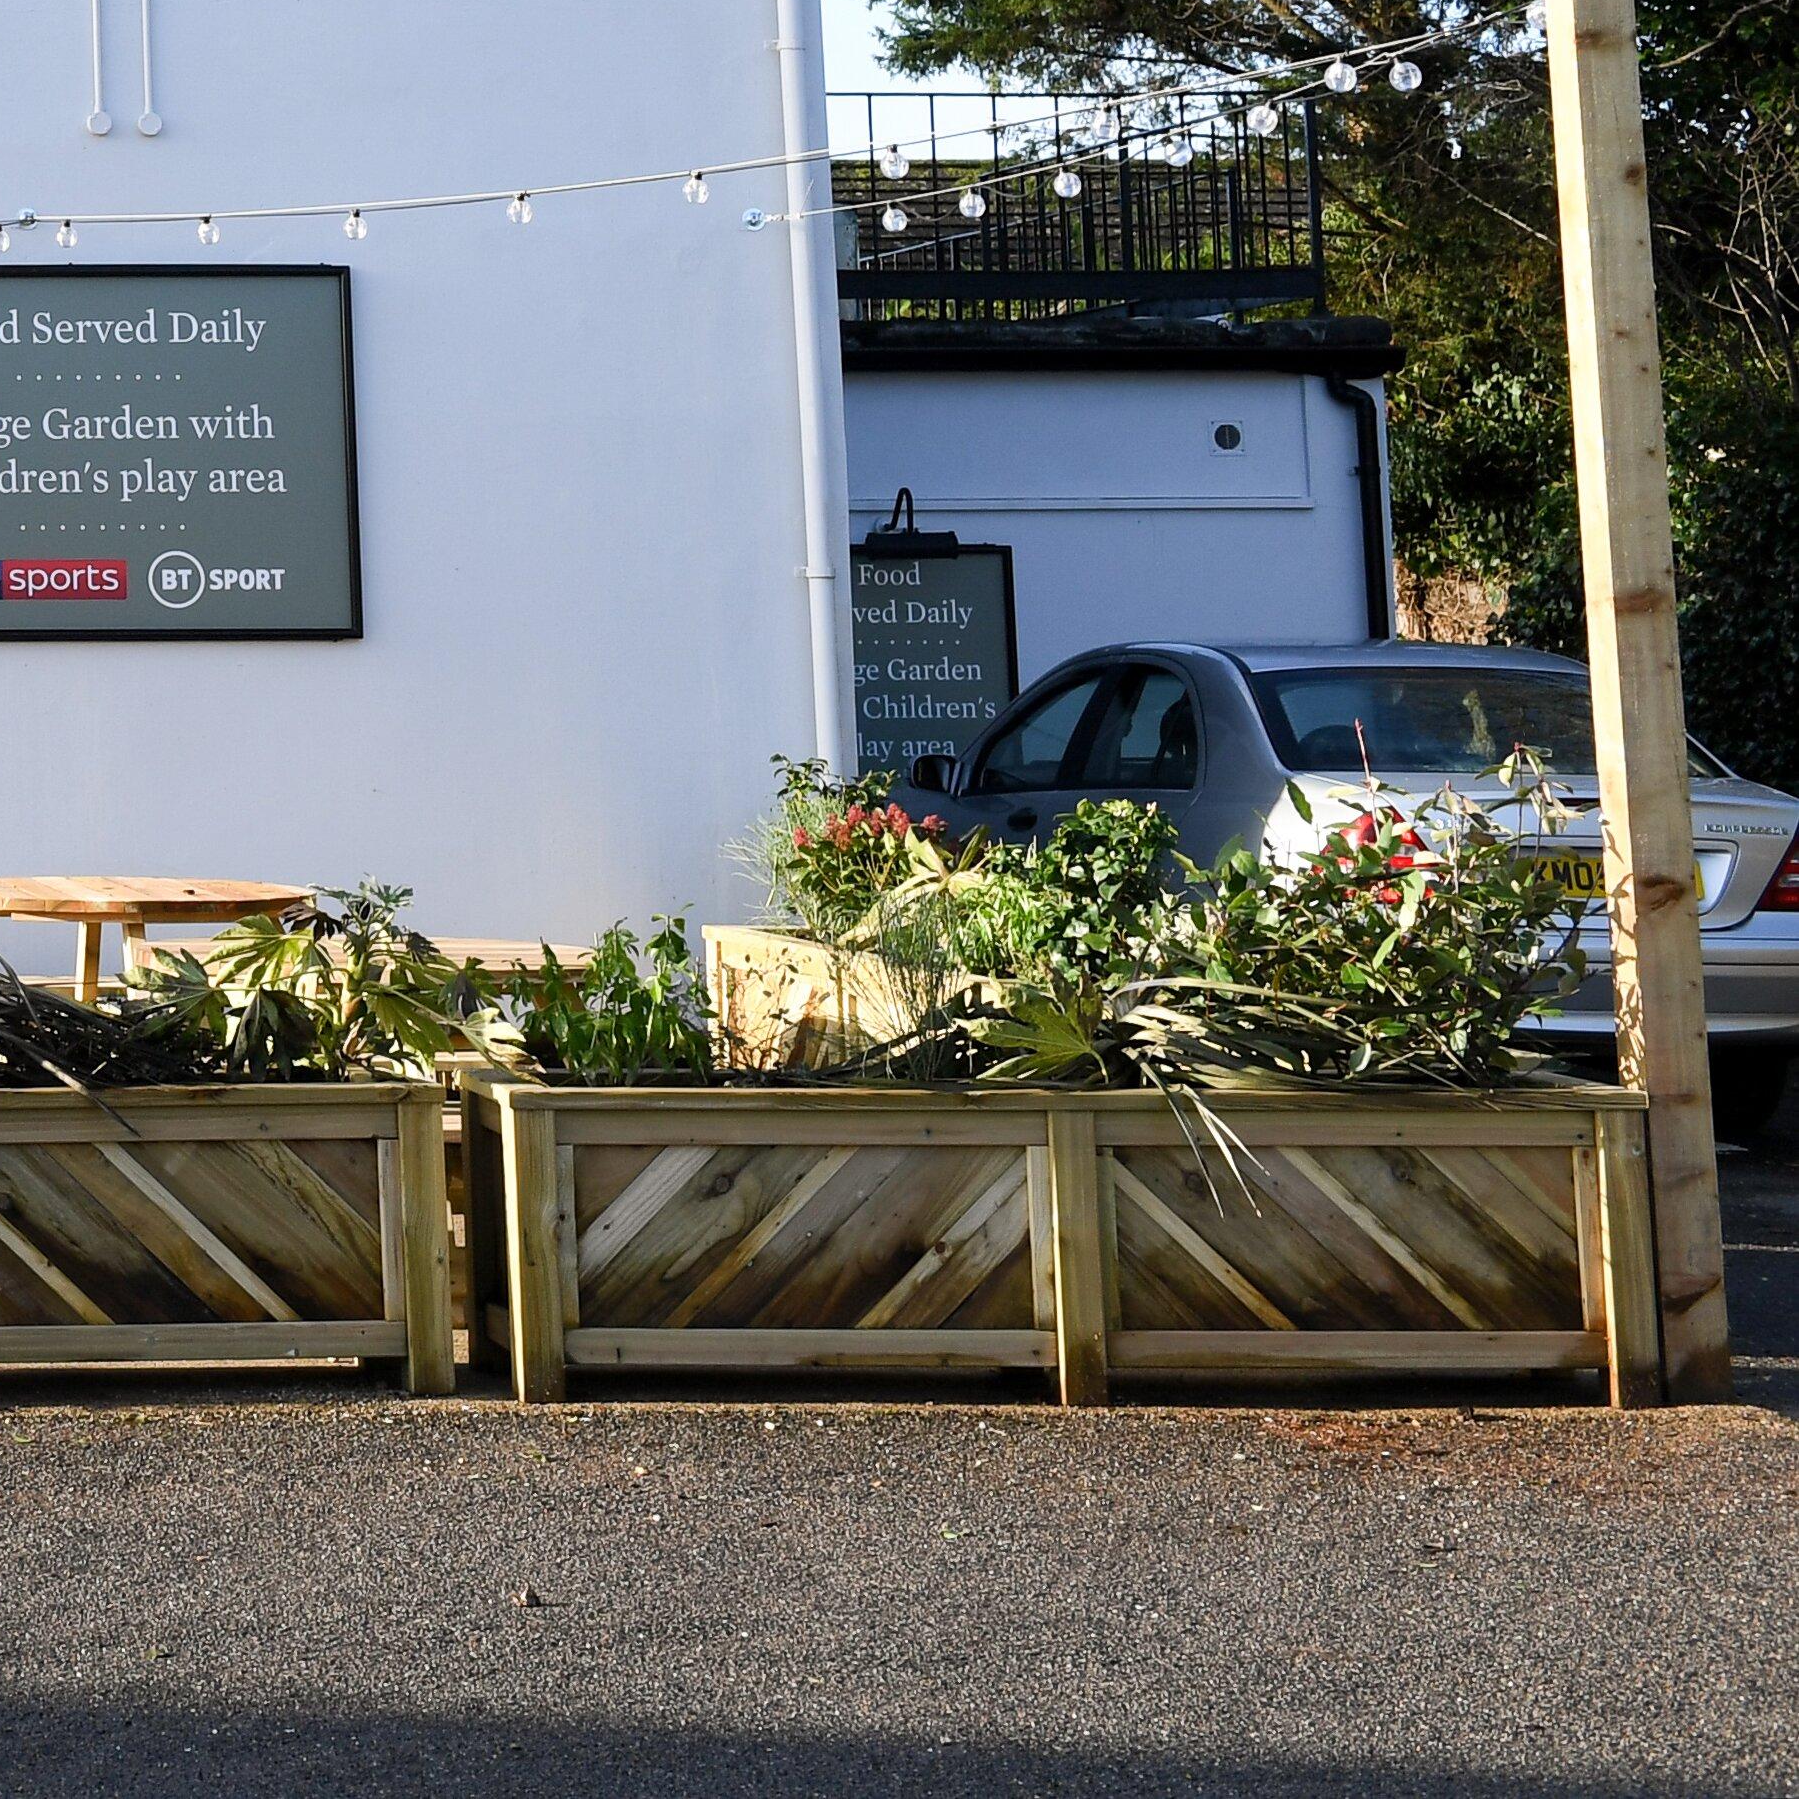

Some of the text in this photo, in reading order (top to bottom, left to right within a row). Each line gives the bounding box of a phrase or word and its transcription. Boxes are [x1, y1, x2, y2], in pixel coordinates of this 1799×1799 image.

[32, 308, 158, 345] Served
[168, 308, 267, 352] Daily
[42, 405, 180, 441] Garden
[189, 404, 275, 441] with
[120, 458, 198, 502] play
[208, 469, 288, 494] area
[8, 564, 120, 598] sports
[160, 568, 286, 592] BT SPORT
[857, 561, 922, 586] Food
[852, 599, 973, 630] ved Daily
[886, 655, 983, 681] Garden
[862, 694, 997, 719] Children's
[857, 732, 957, 763] lay area
